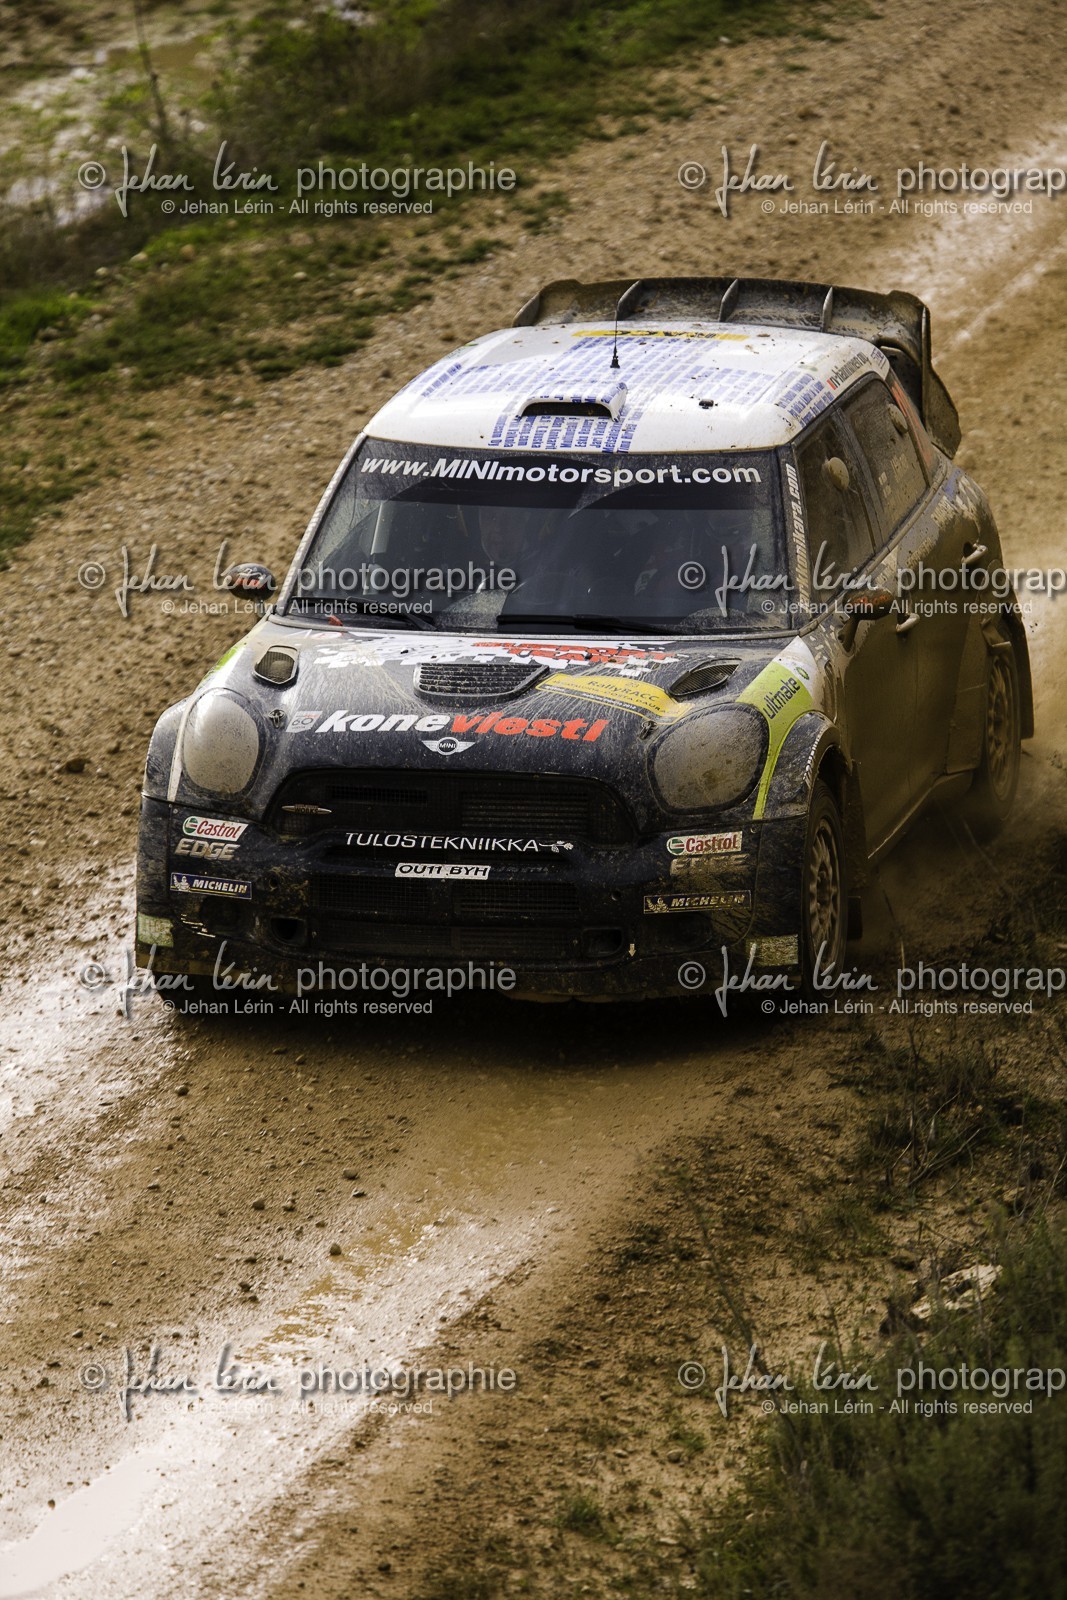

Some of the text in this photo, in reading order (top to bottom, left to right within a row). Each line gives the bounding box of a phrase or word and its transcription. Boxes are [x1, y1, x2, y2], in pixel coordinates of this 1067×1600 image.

[361, 457, 762, 486] www.MINImotorsport.com
[196, 820, 242, 839] Castrol
[174, 837, 241, 860] EDGE
[346, 832, 539, 852] TULOSTEKNIIKKA
[686, 833, 738, 852] Castrol
[449, 866, 490, 876] BYH
[192, 879, 248, 894] MICHELIN
[670, 894, 746, 907] MICHELIN
